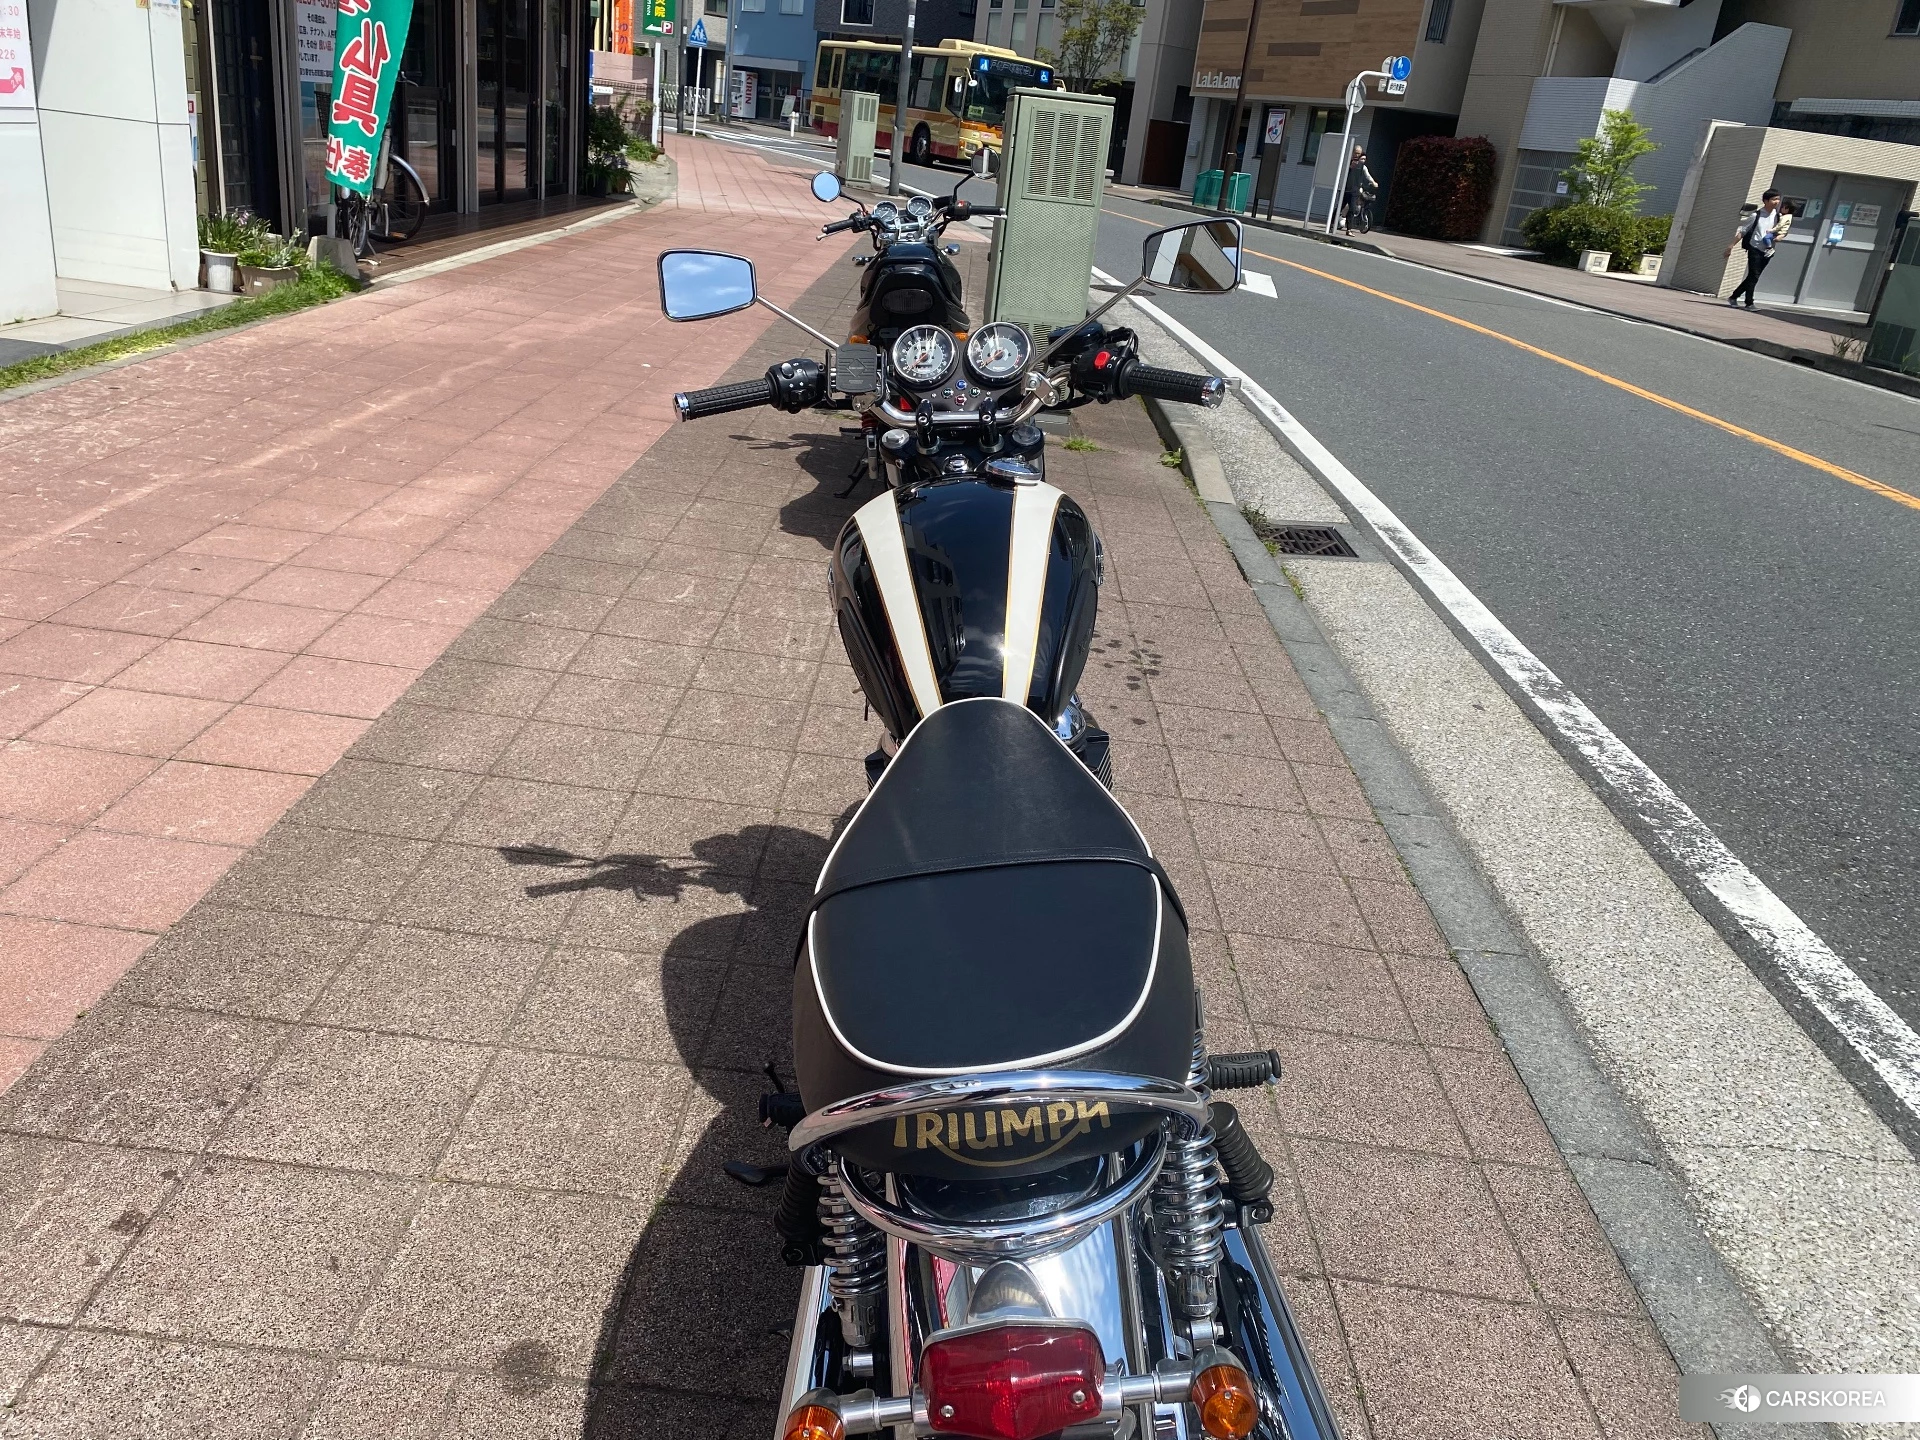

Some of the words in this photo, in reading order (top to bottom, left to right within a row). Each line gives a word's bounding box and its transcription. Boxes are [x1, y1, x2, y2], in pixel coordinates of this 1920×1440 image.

[0, 5, 19, 16] :30
[663, 22, 671, 33] P
[745, 73, 753, 105] KIRIN
[893, 1101, 1111, 1150] TRIUMPH
